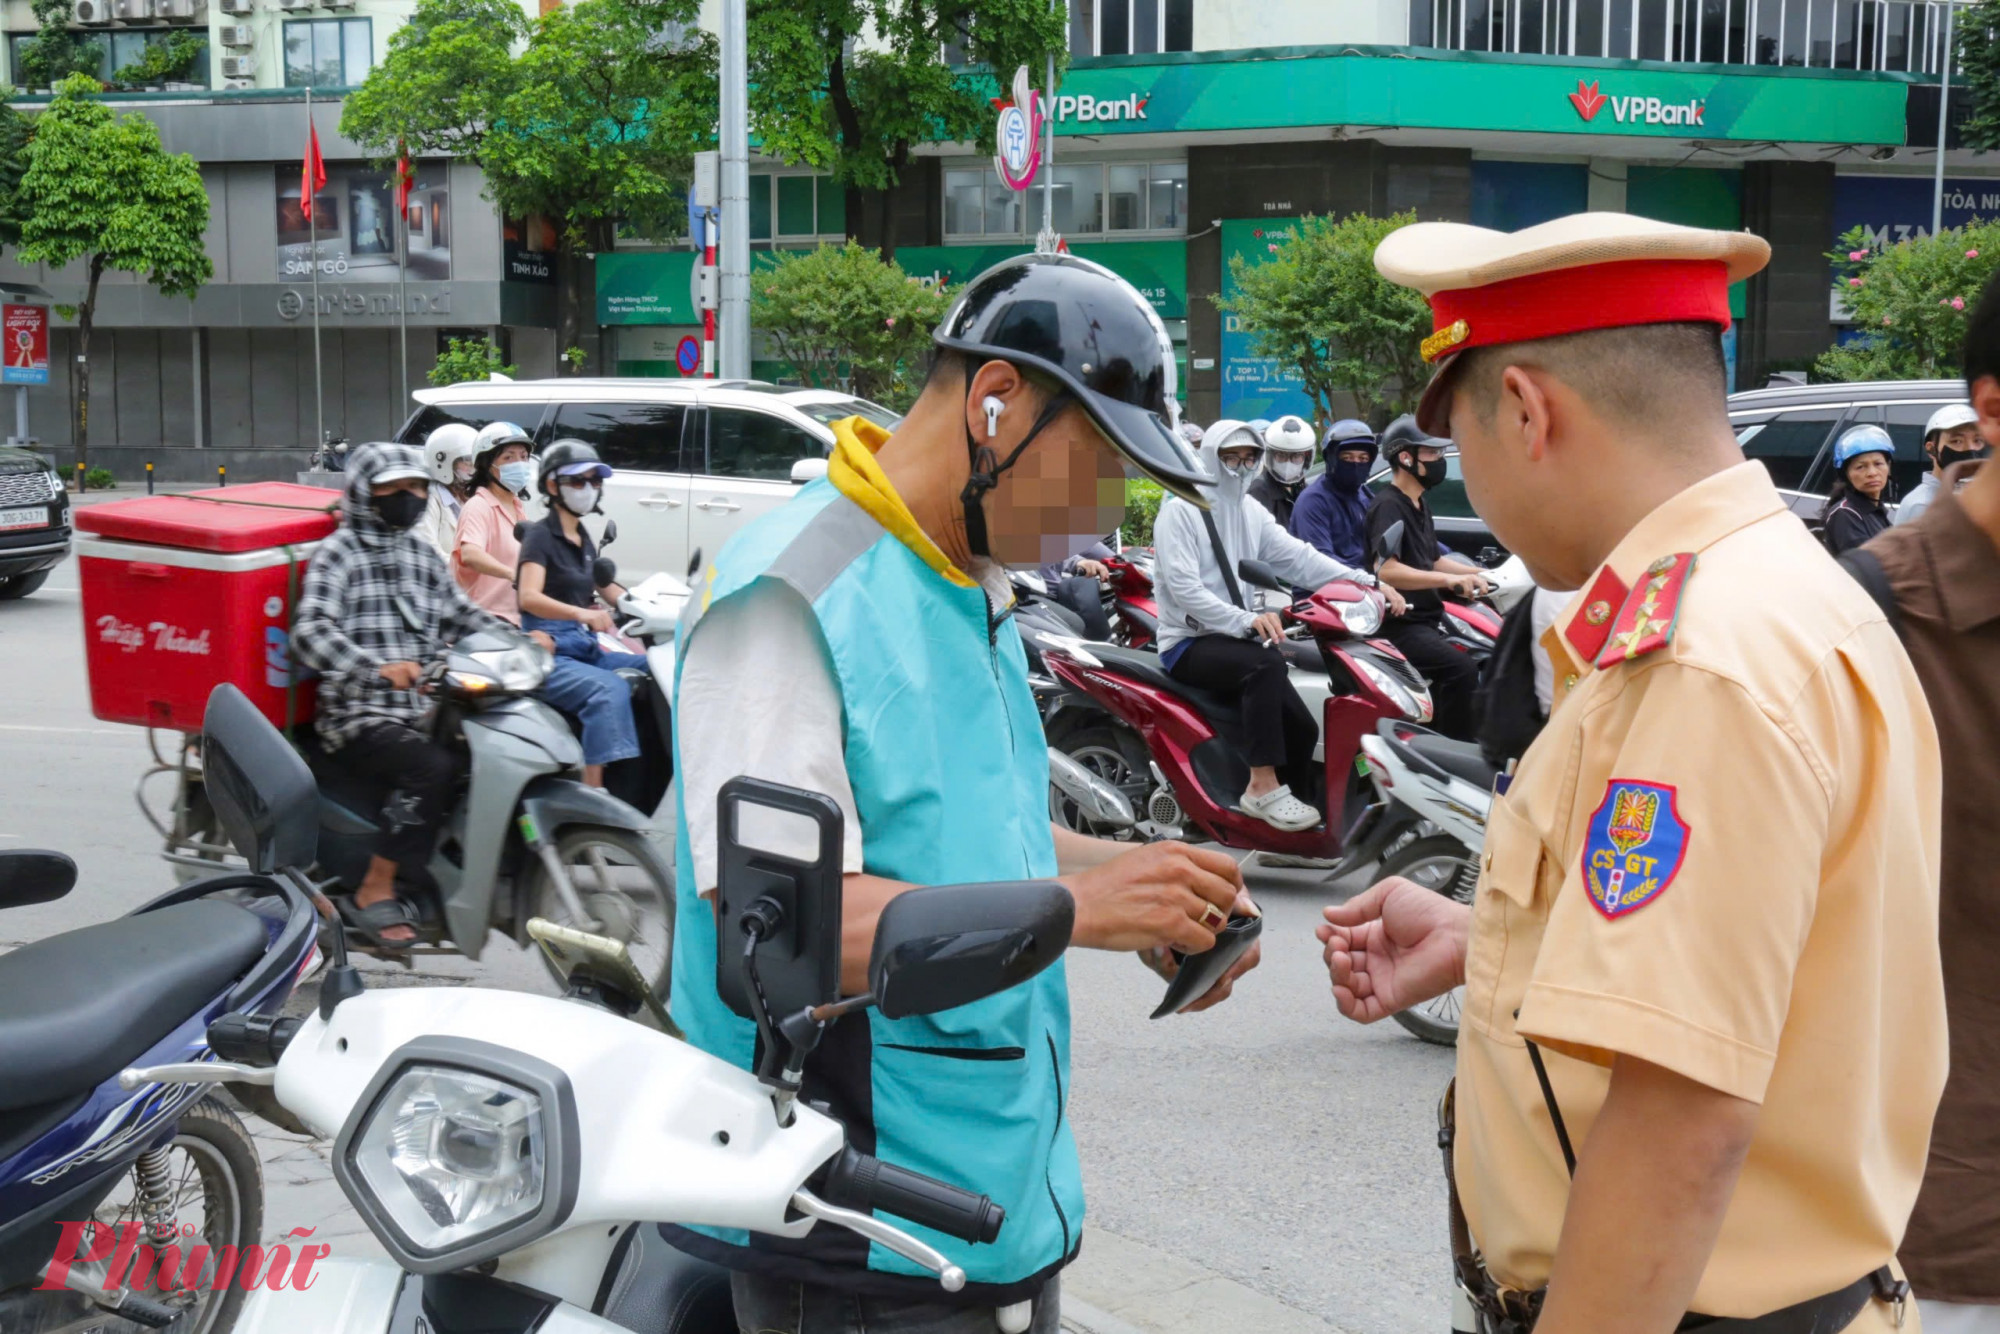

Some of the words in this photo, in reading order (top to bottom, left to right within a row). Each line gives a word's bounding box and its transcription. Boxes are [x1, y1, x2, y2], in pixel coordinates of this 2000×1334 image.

[1037, 93, 1147, 122] VPBank
[1611, 95, 1705, 125] VPBank
[1943, 188, 1976, 209] TÒA
[1265, 231, 1291, 240] VPBa
[322, 252, 348, 274] GỖ
[1155, 288, 1166, 298] 15
[1082, 671, 1123, 690] VISION
[1592, 849, 1616, 869] CS
[1625, 853, 1658, 877] GT
